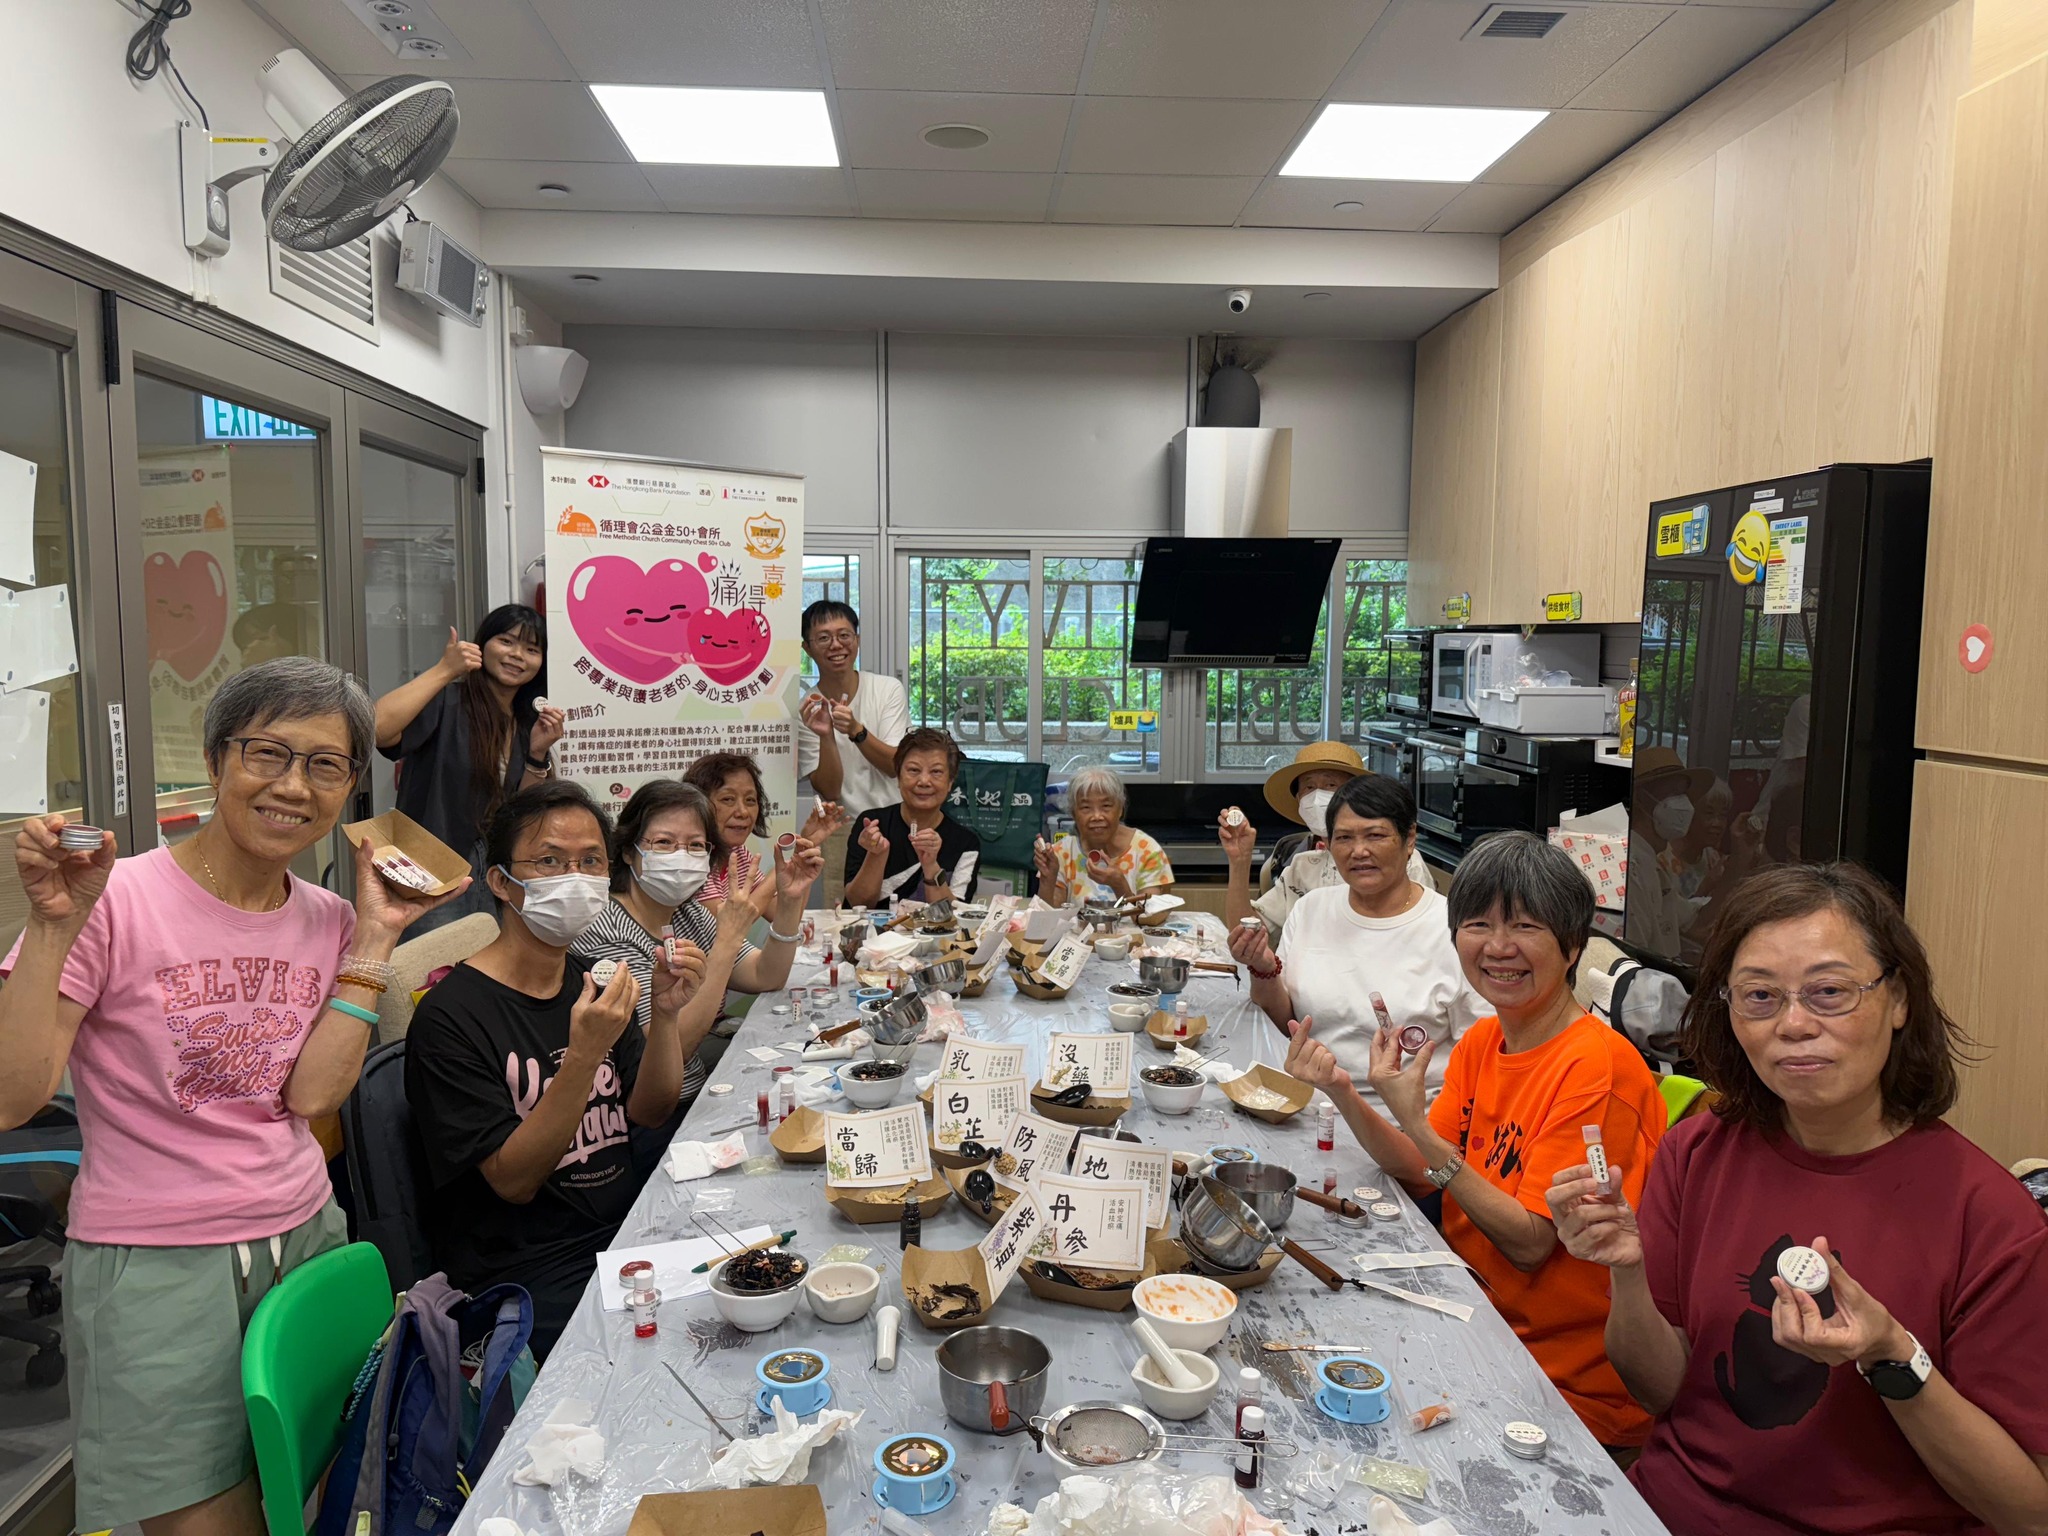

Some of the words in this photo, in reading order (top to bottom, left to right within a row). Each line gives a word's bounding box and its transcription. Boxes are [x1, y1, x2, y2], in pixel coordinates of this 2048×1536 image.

[622, 485, 648, 494] Hongkong
[600, 519, 720, 541] 循理會公益金50+會所
[661, 537, 691, 545] Community
[1660, 524, 1680, 545] 雪櫃
[692, 668, 774, 704] 身心支援計劃
[563, 703, 606, 721] 劃簡介
[1114, 715, 1133, 725] 爐具
[155, 957, 321, 1014] ELVIS
[948, 1092, 984, 1140] 白芷
[837, 1127, 878, 1178] 當歸
[1013, 1125, 1037, 1182] 防風
[1082, 1155, 1109, 1180] 地
[1049, 1194, 1088, 1256] 丹參
